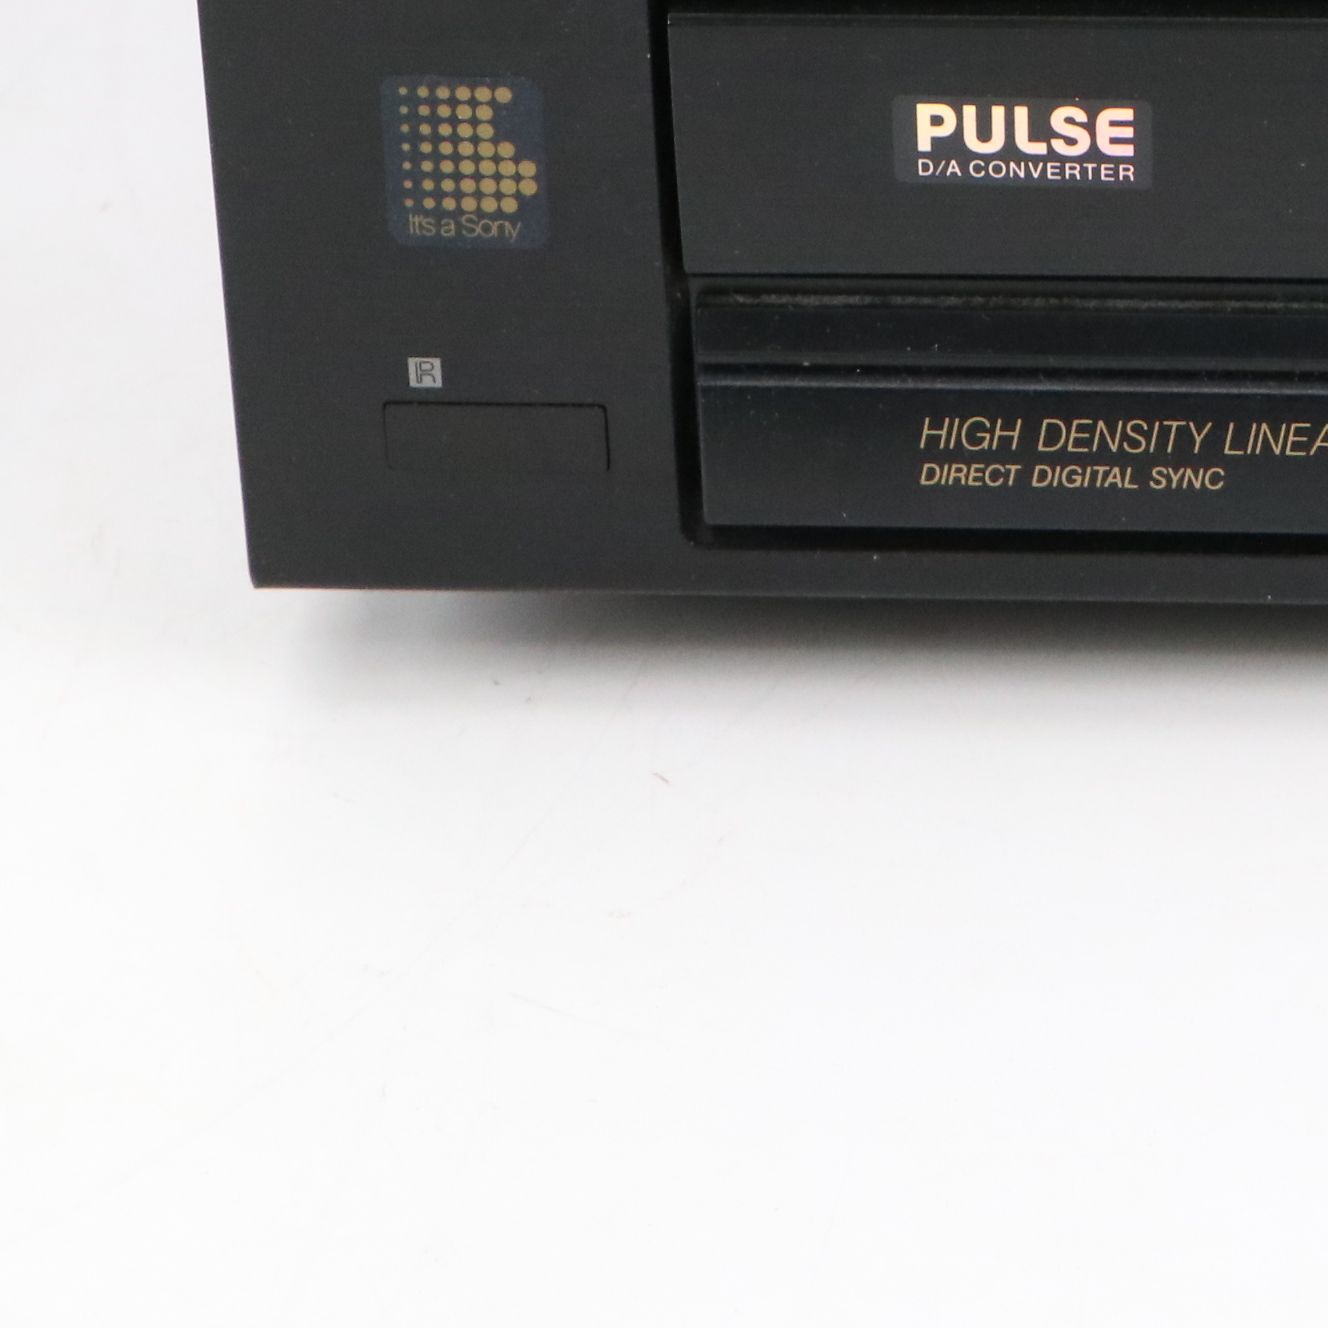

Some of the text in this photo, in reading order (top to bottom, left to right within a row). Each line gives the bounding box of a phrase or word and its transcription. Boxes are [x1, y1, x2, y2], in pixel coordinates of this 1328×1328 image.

[915, 103, 1135, 157] PULSE
[917, 158, 1135, 182] D/A CONVERTER
[408, 213, 521, 243] It's a Sony
[919, 416, 1022, 452] HIGH
[1037, 418, 1213, 455] DENSITY
[920, 463, 1225, 491] DIRECT DIGITAL SYNC
